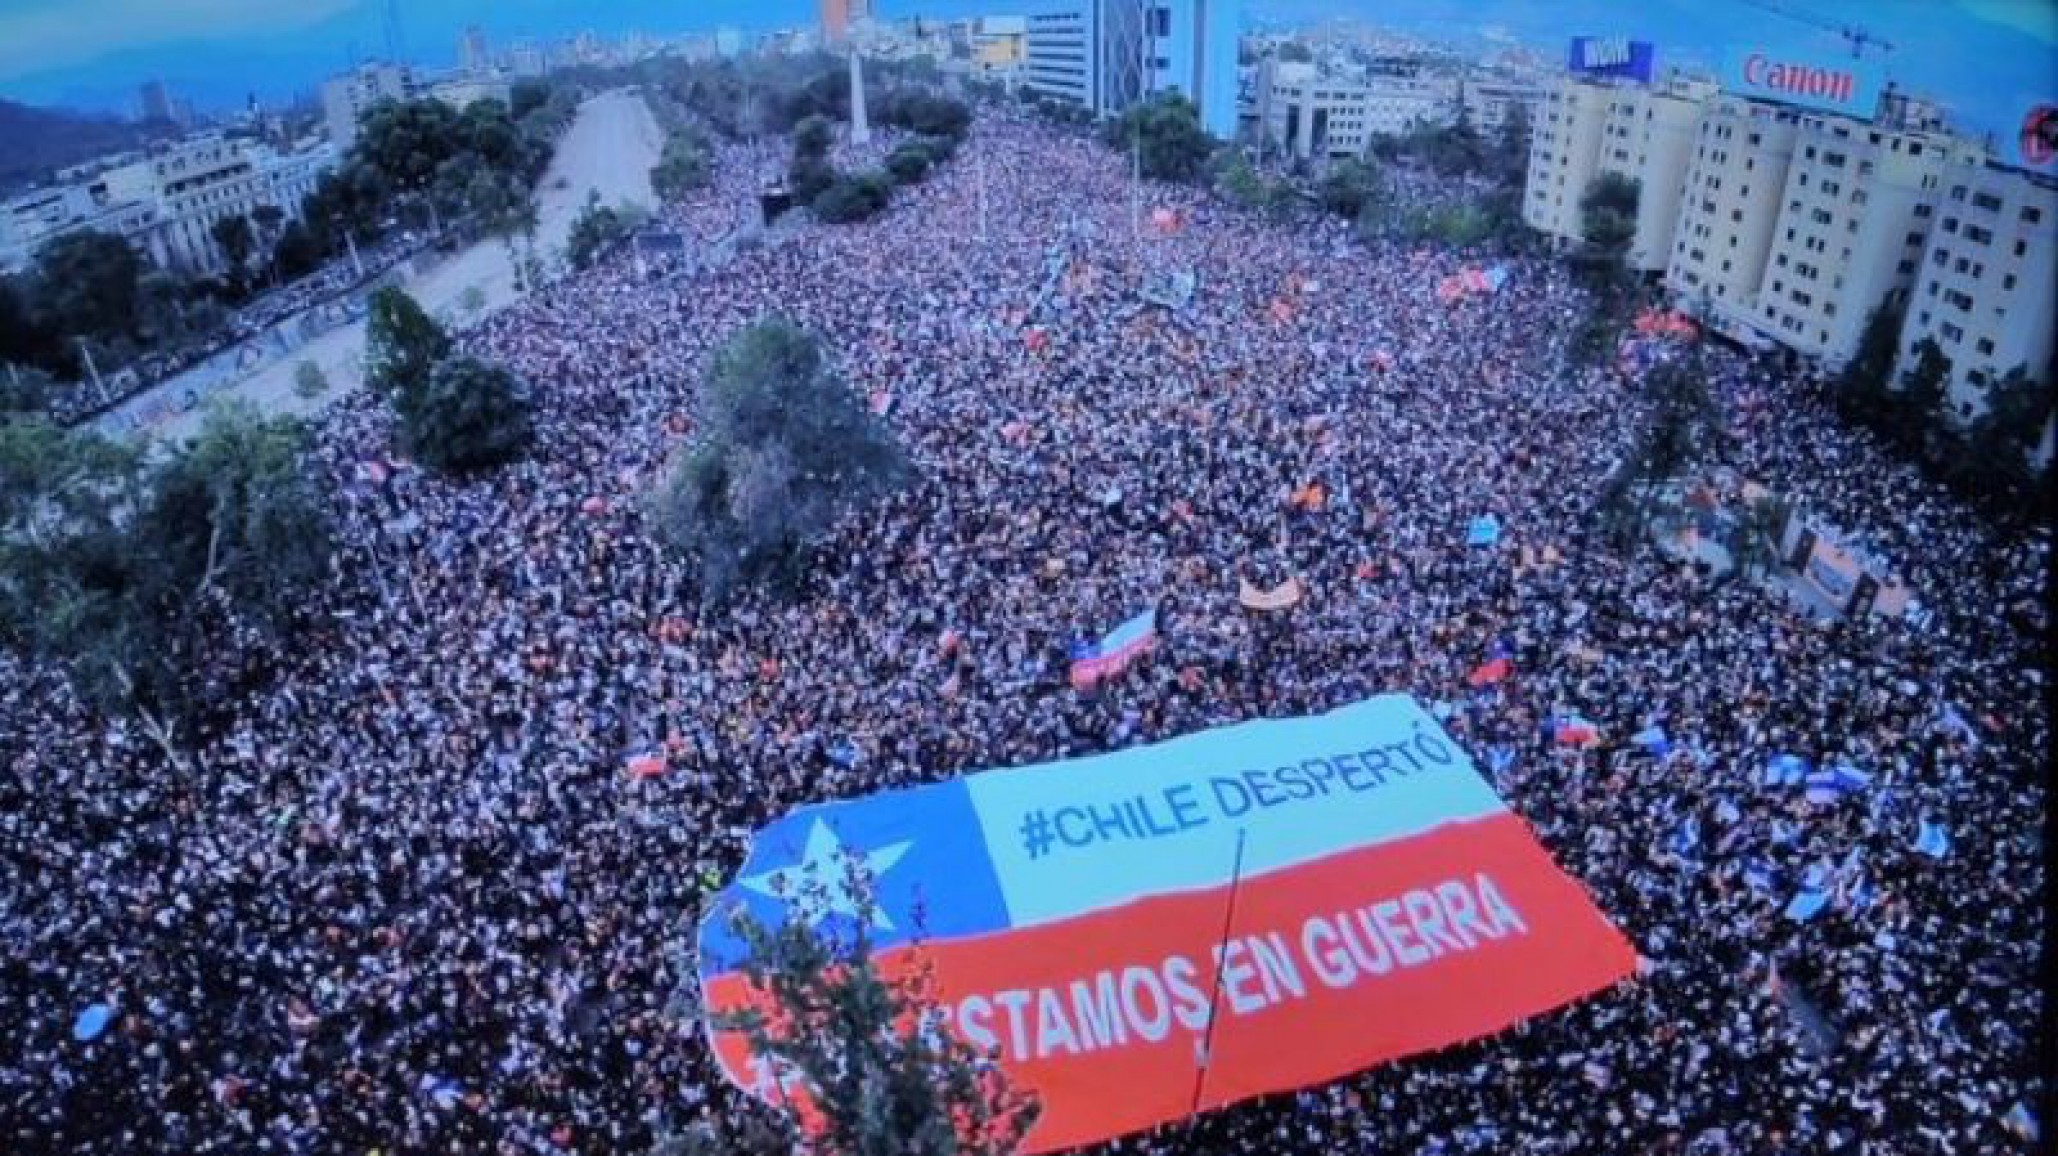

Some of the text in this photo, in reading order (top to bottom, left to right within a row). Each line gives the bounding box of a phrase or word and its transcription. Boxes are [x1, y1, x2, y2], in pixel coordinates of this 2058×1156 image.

[1744, 52, 1853, 103] Canon
[1019, 720, 1453, 860] #CHILE DESPERTÓ
[1211, 931, 1306, 1014] EN
[1301, 872, 1529, 987] GUERRA
